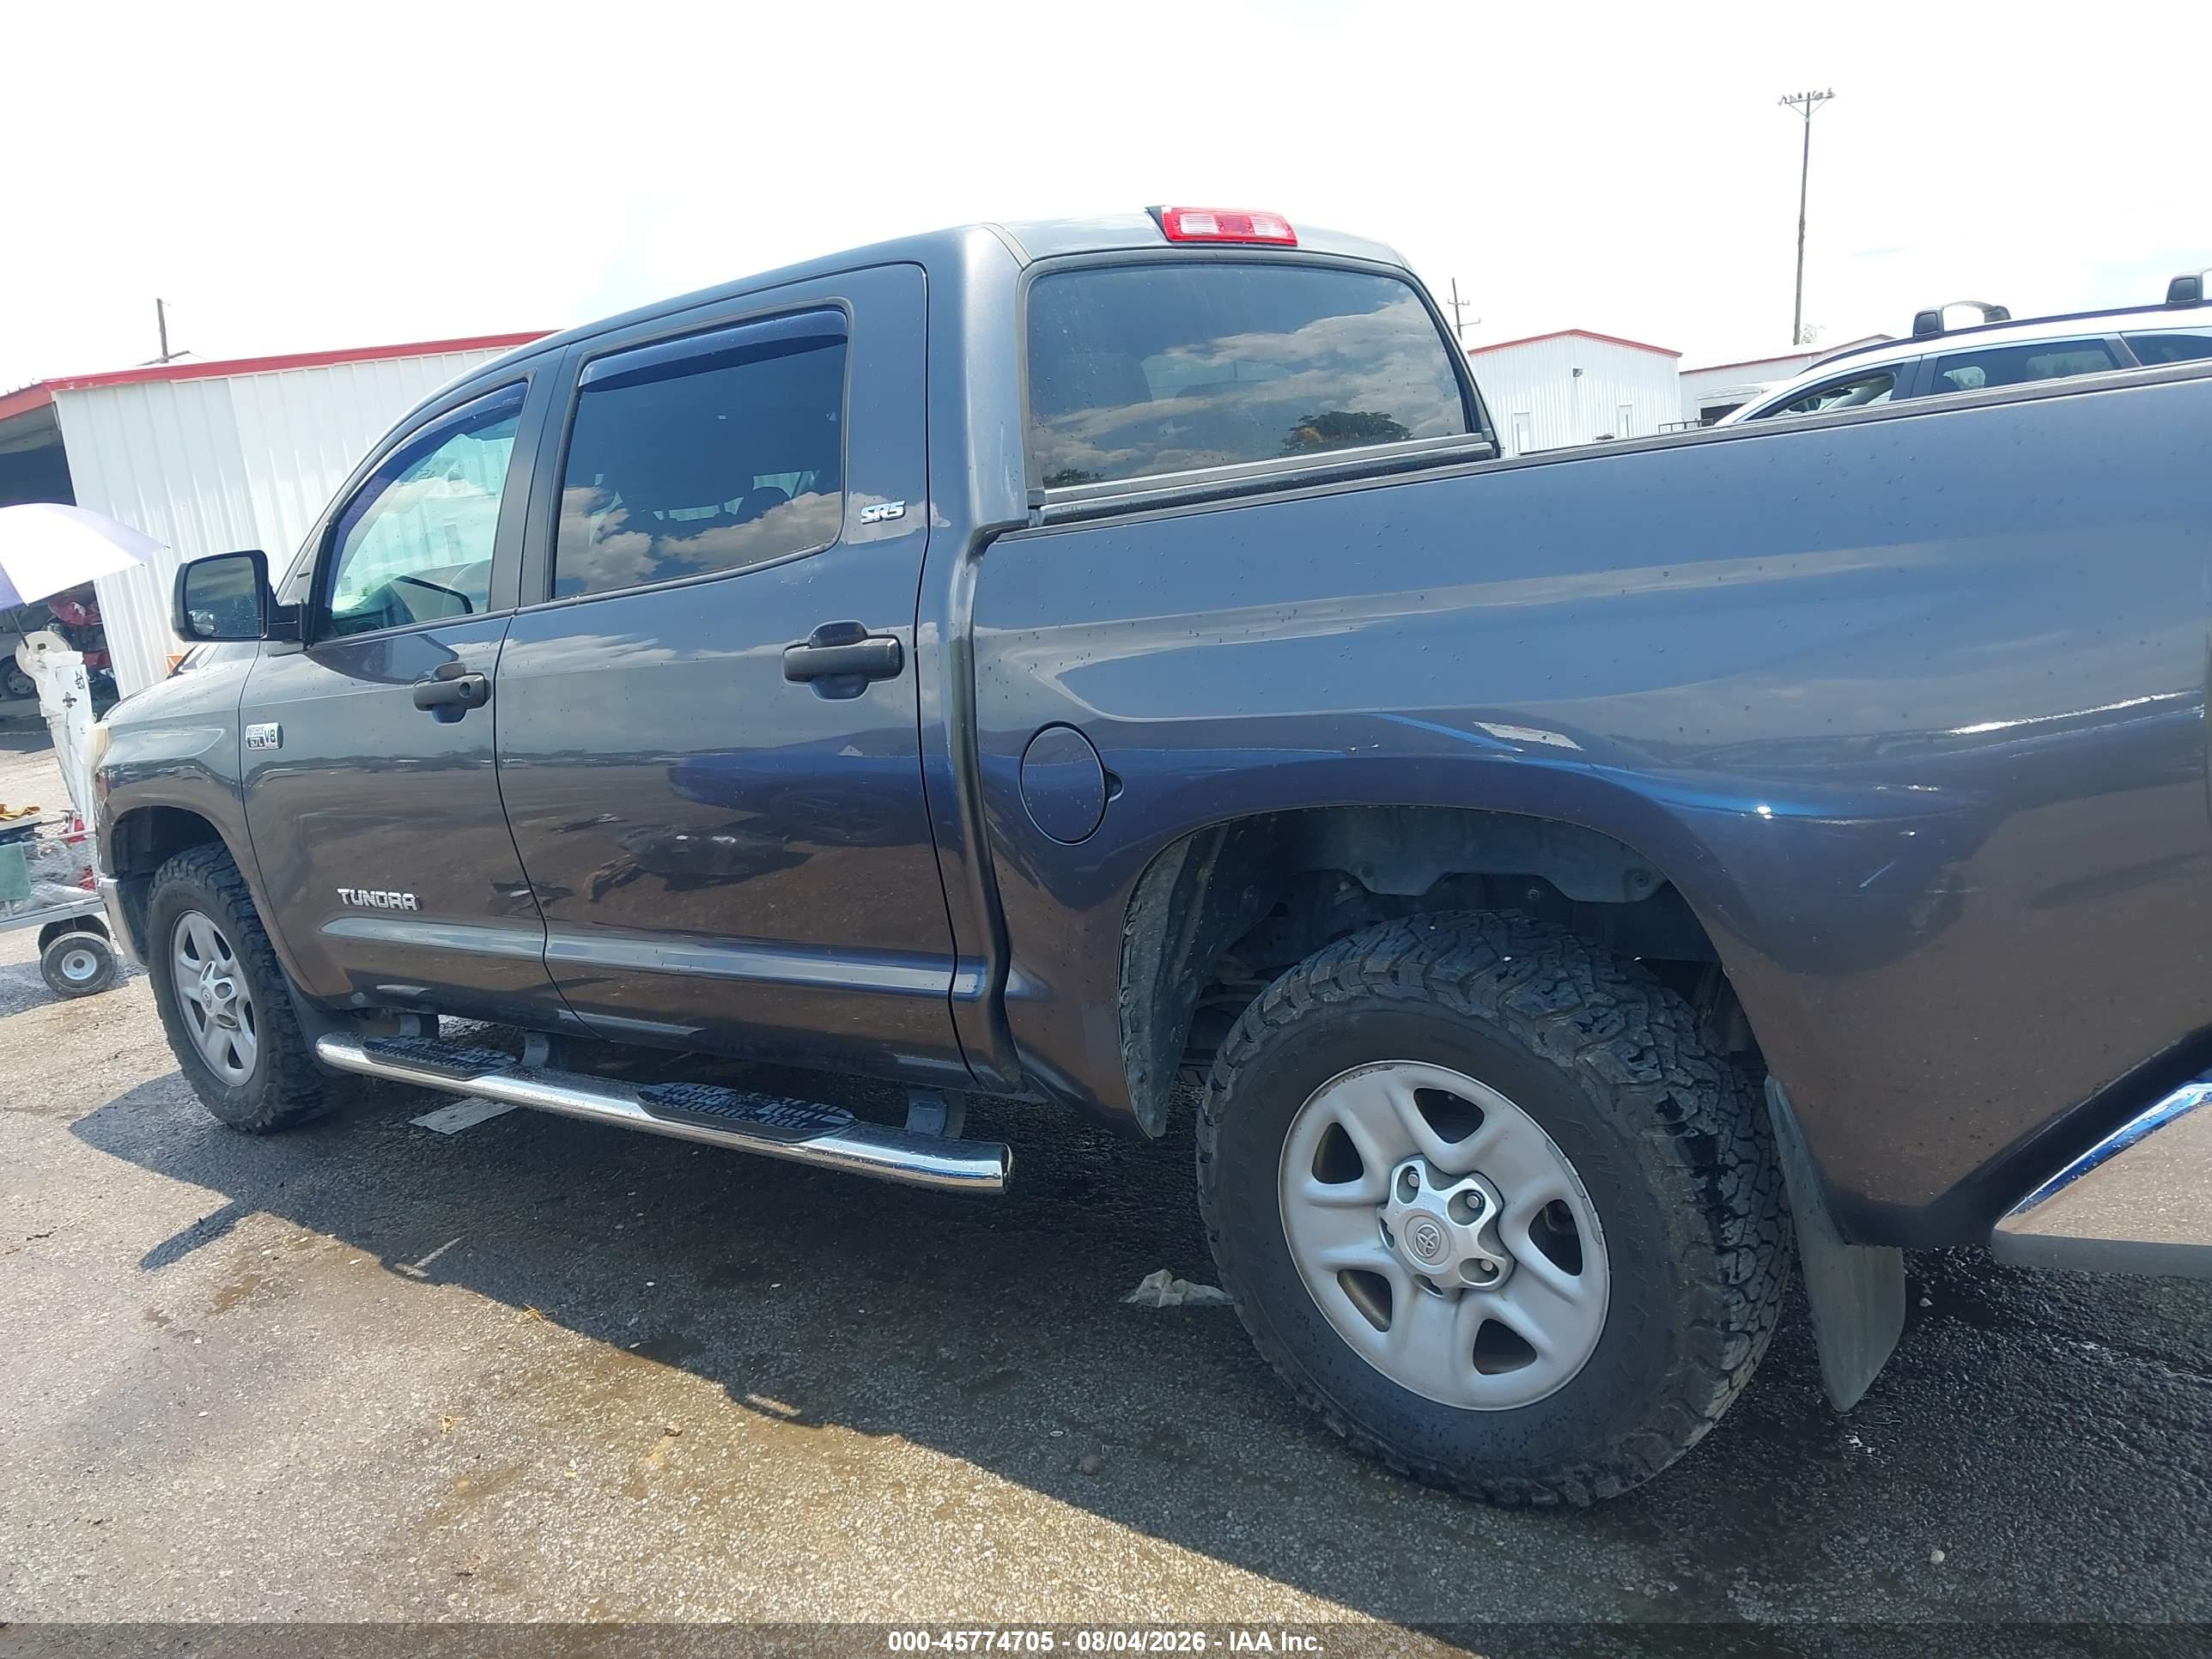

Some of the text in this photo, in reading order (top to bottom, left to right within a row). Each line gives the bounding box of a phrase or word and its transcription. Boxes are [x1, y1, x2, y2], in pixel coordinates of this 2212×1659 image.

[860, 500, 906, 524] SR5
[264, 728, 276, 744] V8
[336, 888, 419, 911] TUNDRA
